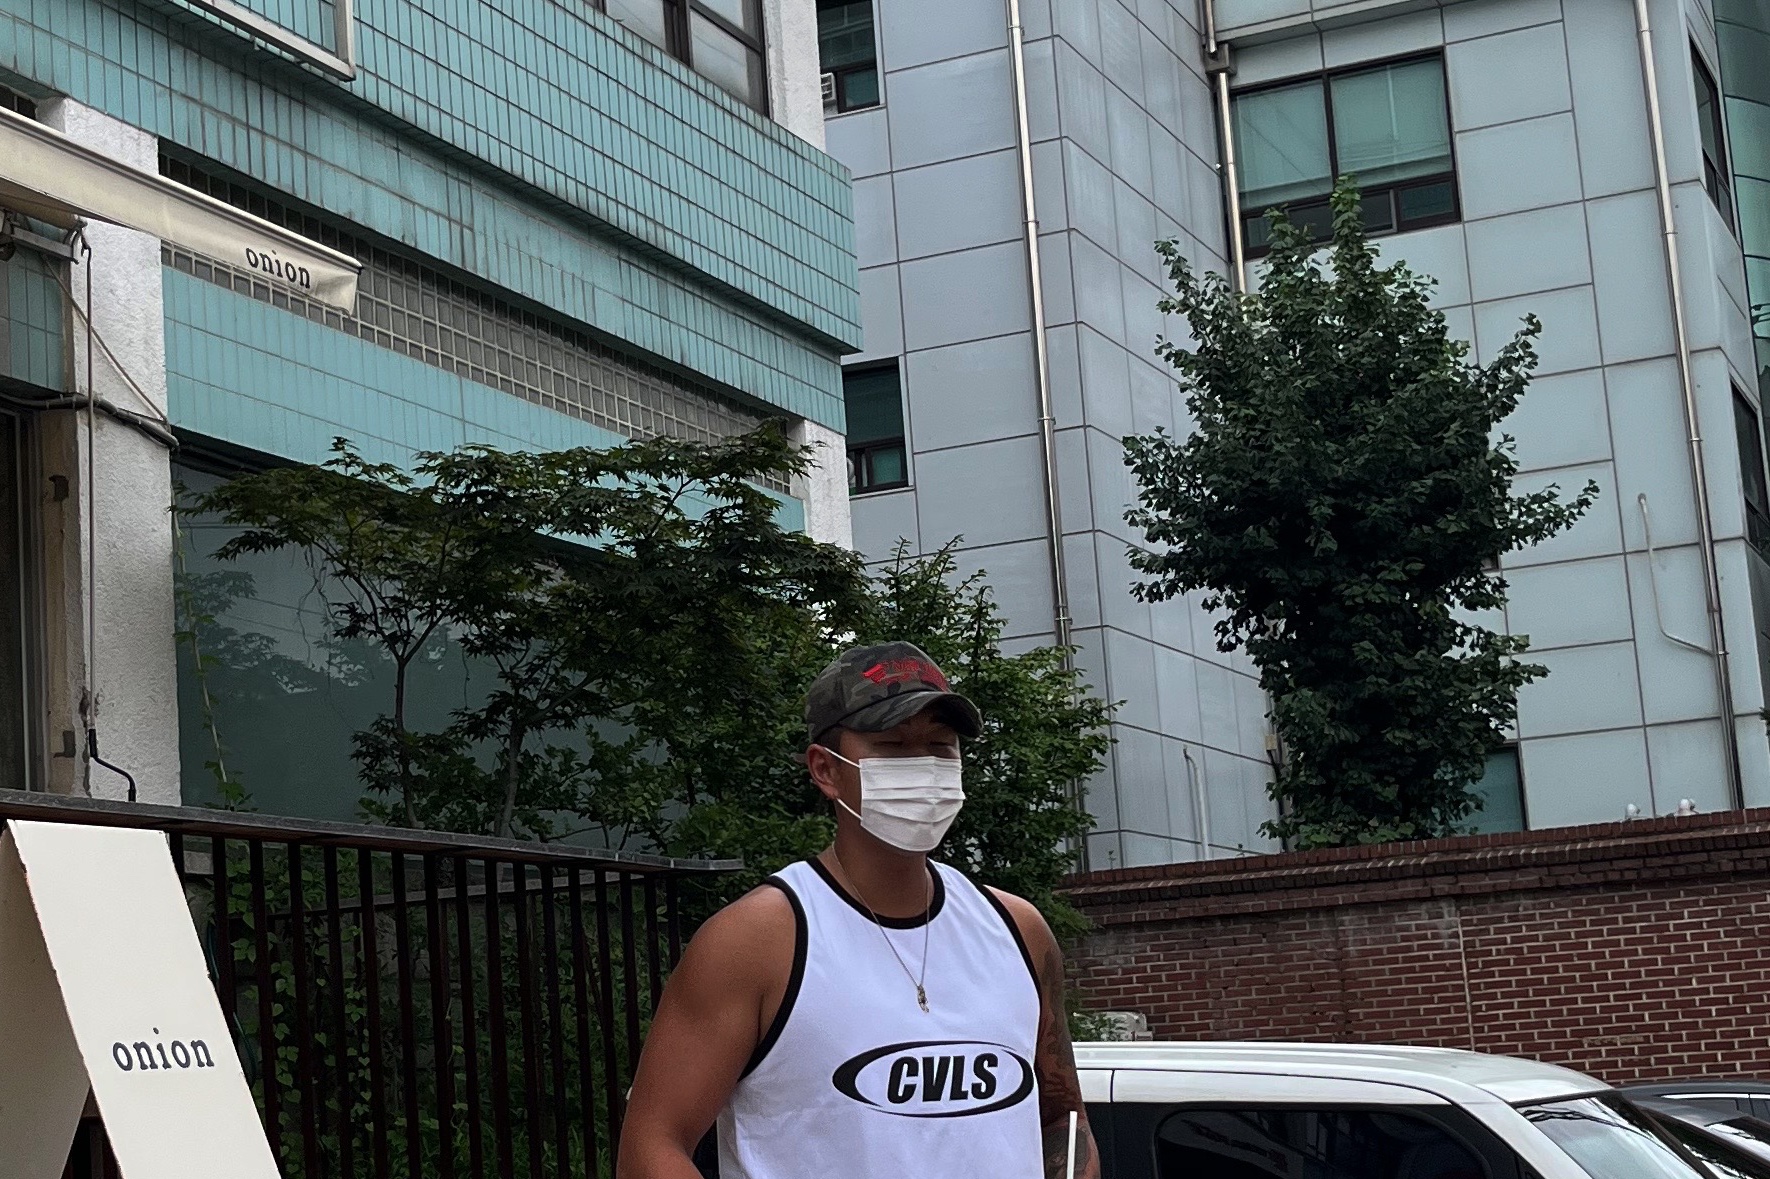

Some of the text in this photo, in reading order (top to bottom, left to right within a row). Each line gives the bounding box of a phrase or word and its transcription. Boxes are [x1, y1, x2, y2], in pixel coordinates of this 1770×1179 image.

[245, 247, 311, 289] onion
[112, 1027, 215, 1072] onion
[887, 1053, 999, 1104] CVLS
